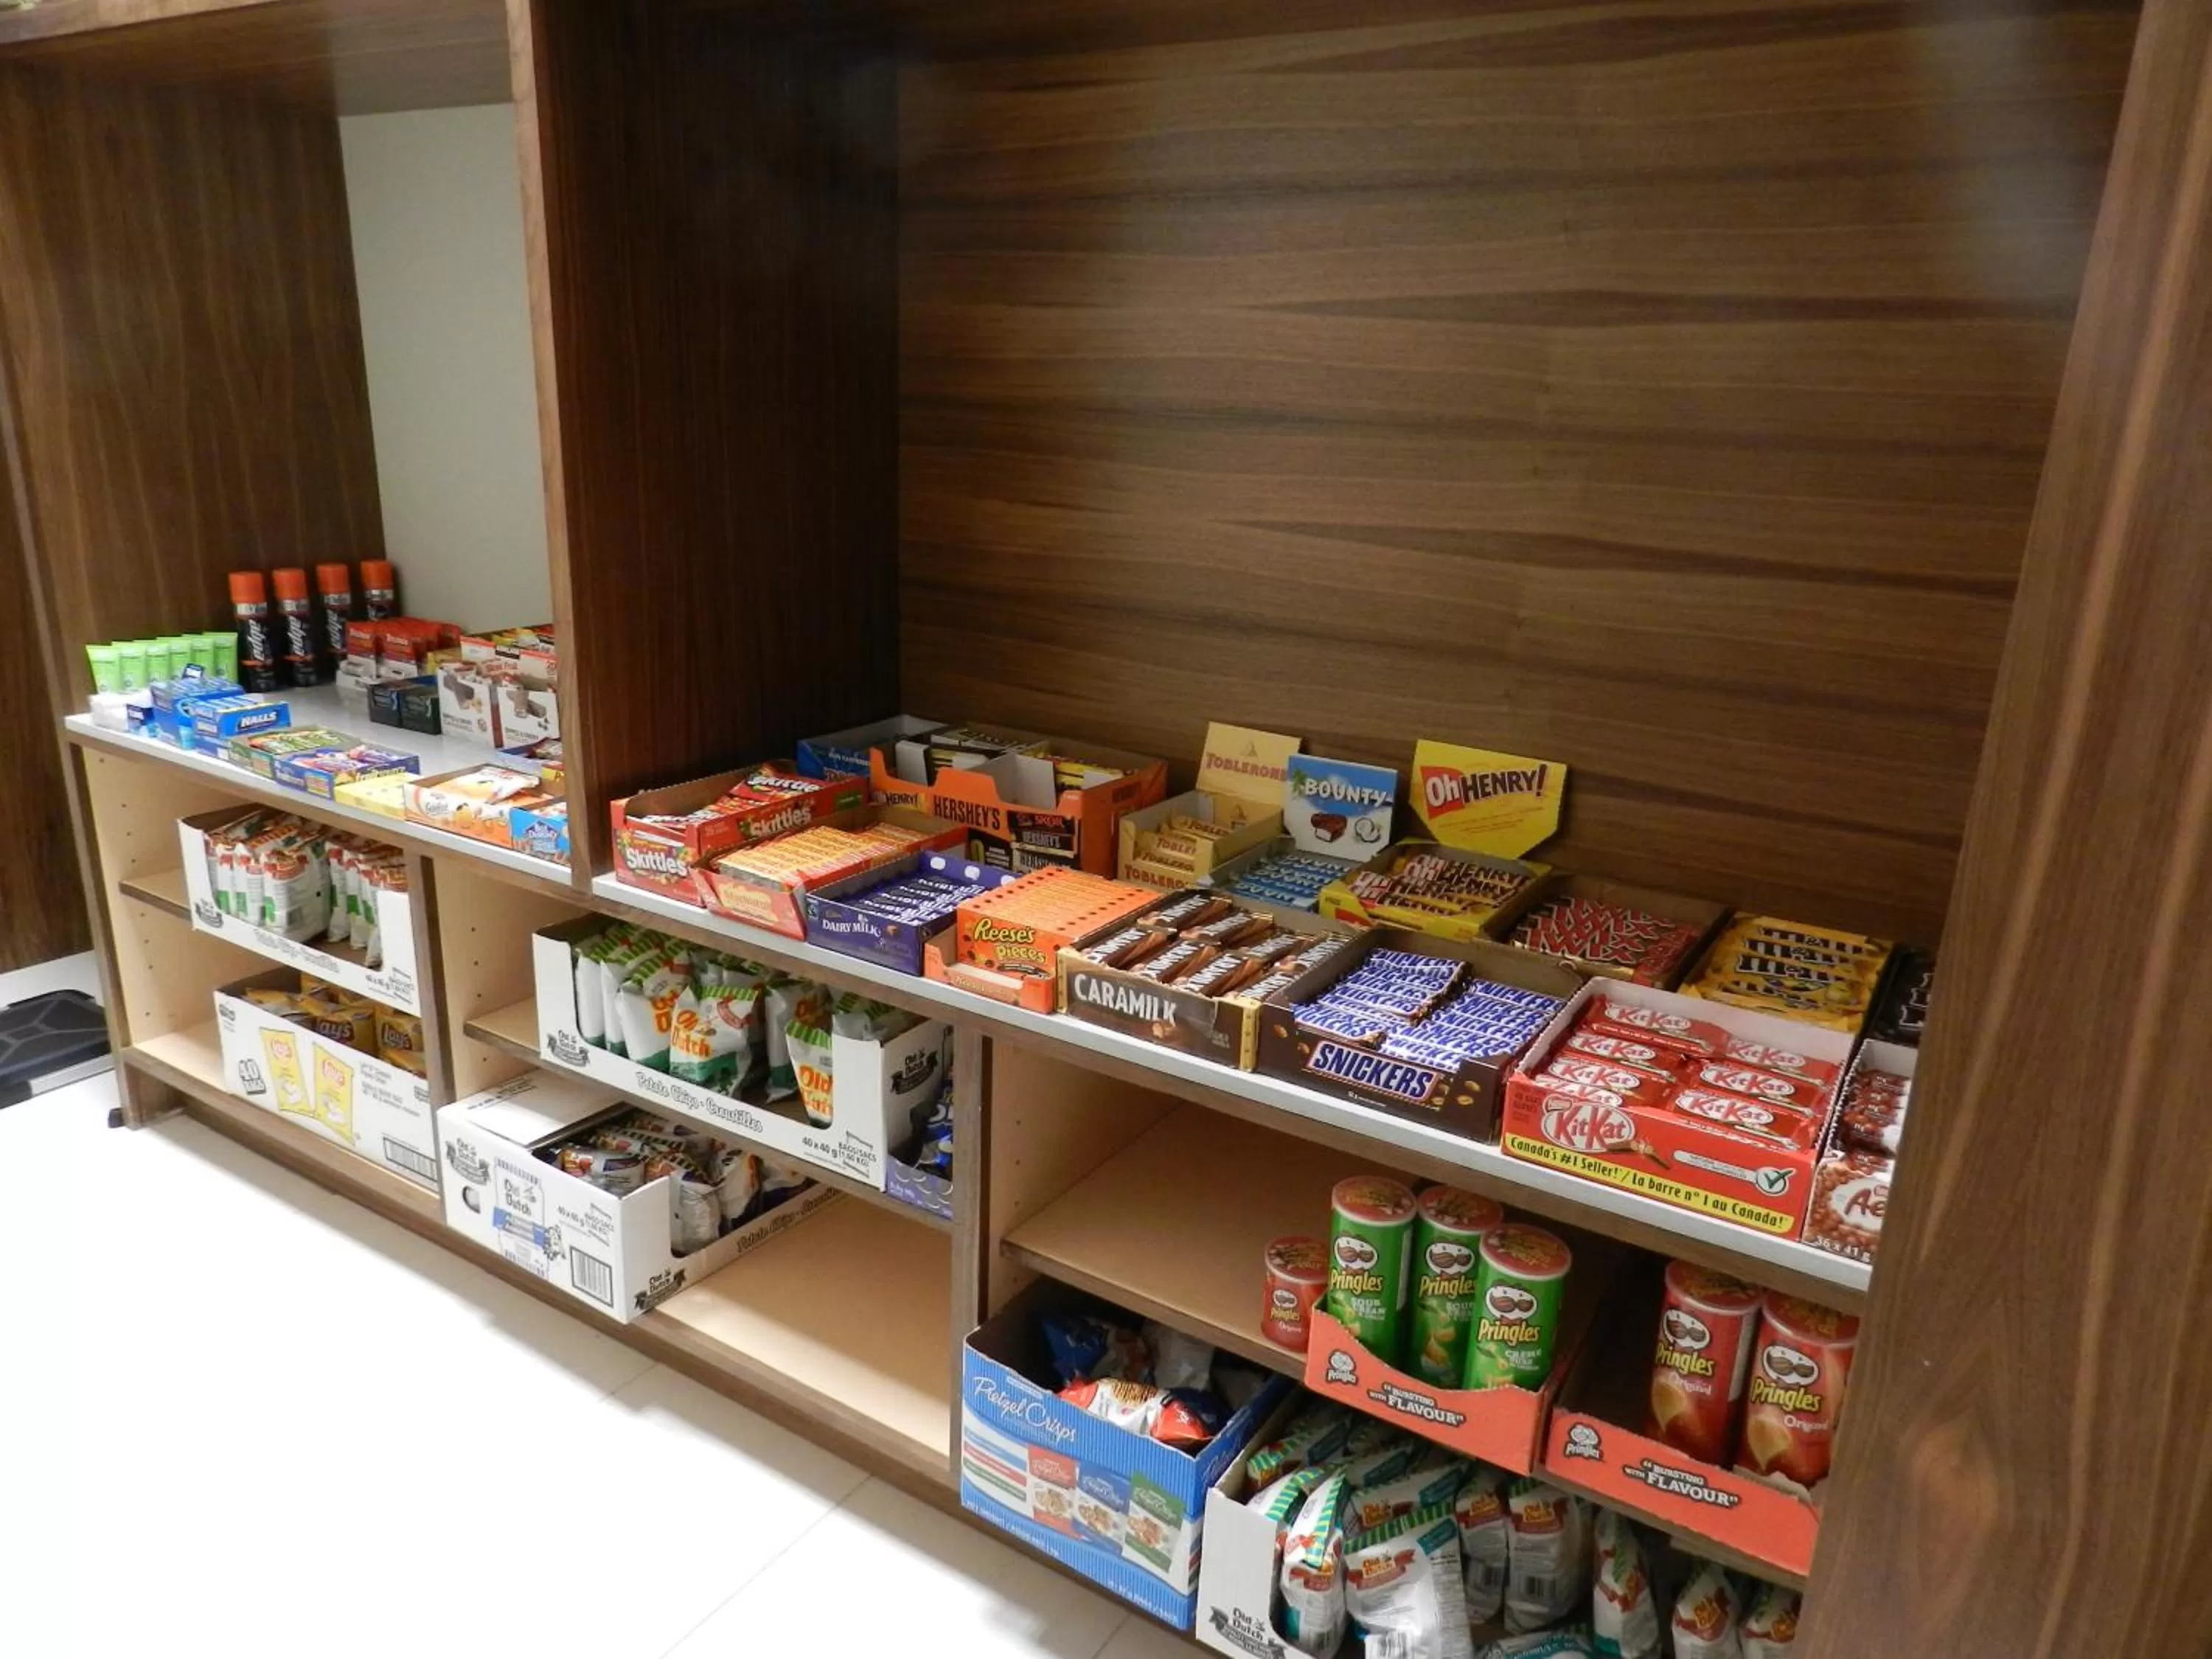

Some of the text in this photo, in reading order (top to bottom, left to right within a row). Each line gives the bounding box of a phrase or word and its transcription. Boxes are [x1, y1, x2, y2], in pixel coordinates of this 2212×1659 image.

[240, 712, 276, 727] HALLS
[1304, 778, 1387, 807] BOUNTY
[1426, 764, 1548, 807] Oh HENRY!
[749, 807, 812, 838] Skittles
[933, 795, 1001, 830] HERSHEY'S
[626, 847, 688, 877] Skittles
[1124, 863, 1189, 889] TOBLERO
[822, 919, 881, 937] DAIRY MILK
[974, 917, 1035, 944] Reese's
[995, 945, 1046, 963] pieces
[1074, 974, 1177, 1023] CARAMILK
[1618, 1005, 1686, 1030] KitKat
[672, 1024, 712, 1057] Dutch
[1581, 1036, 1646, 1060] KitKat
[1731, 1041, 1797, 1067] KitKat
[799, 1064, 832, 1093] Old
[1313, 1042, 1435, 1098] SNICKERS
[1562, 1062, 1632, 1087] KitKat
[1714, 1070, 1787, 1095] KitKat
[1691, 1095, 1765, 1123] KitKat
[1554, 1104, 1627, 1152] KitKat
[1511, 1136, 1557, 1161] Canada's
[1559, 1152, 1579, 1166] #1
[1581, 1158, 1618, 1178] Seller!
[1632, 1174, 1644, 1186] La
[1648, 1176, 1680, 1198] barre
[1712, 1199, 1727, 1211] au
[1732, 1203, 1784, 1228] Canada!
[1845, 1187, 1887, 1217] Ae
[1330, 1269, 1384, 1295] Pringles
[1270, 1307, 1301, 1322] Pringles
[1478, 1316, 1540, 1348] Pringles
[1655, 1343, 1715, 1377] Pringles
[1327, 1369, 1357, 1384] Pringles
[1750, 1377, 1822, 1414] Pringles
[973, 1377, 1077, 1447] Pretzel Crisps
[1565, 1443, 1601, 1459] Pringles
[1625, 1467, 1645, 1478] WITH
[1653, 1464, 1705, 1486] BURSTING
[1233, 1618, 1264, 1641] Dutch
